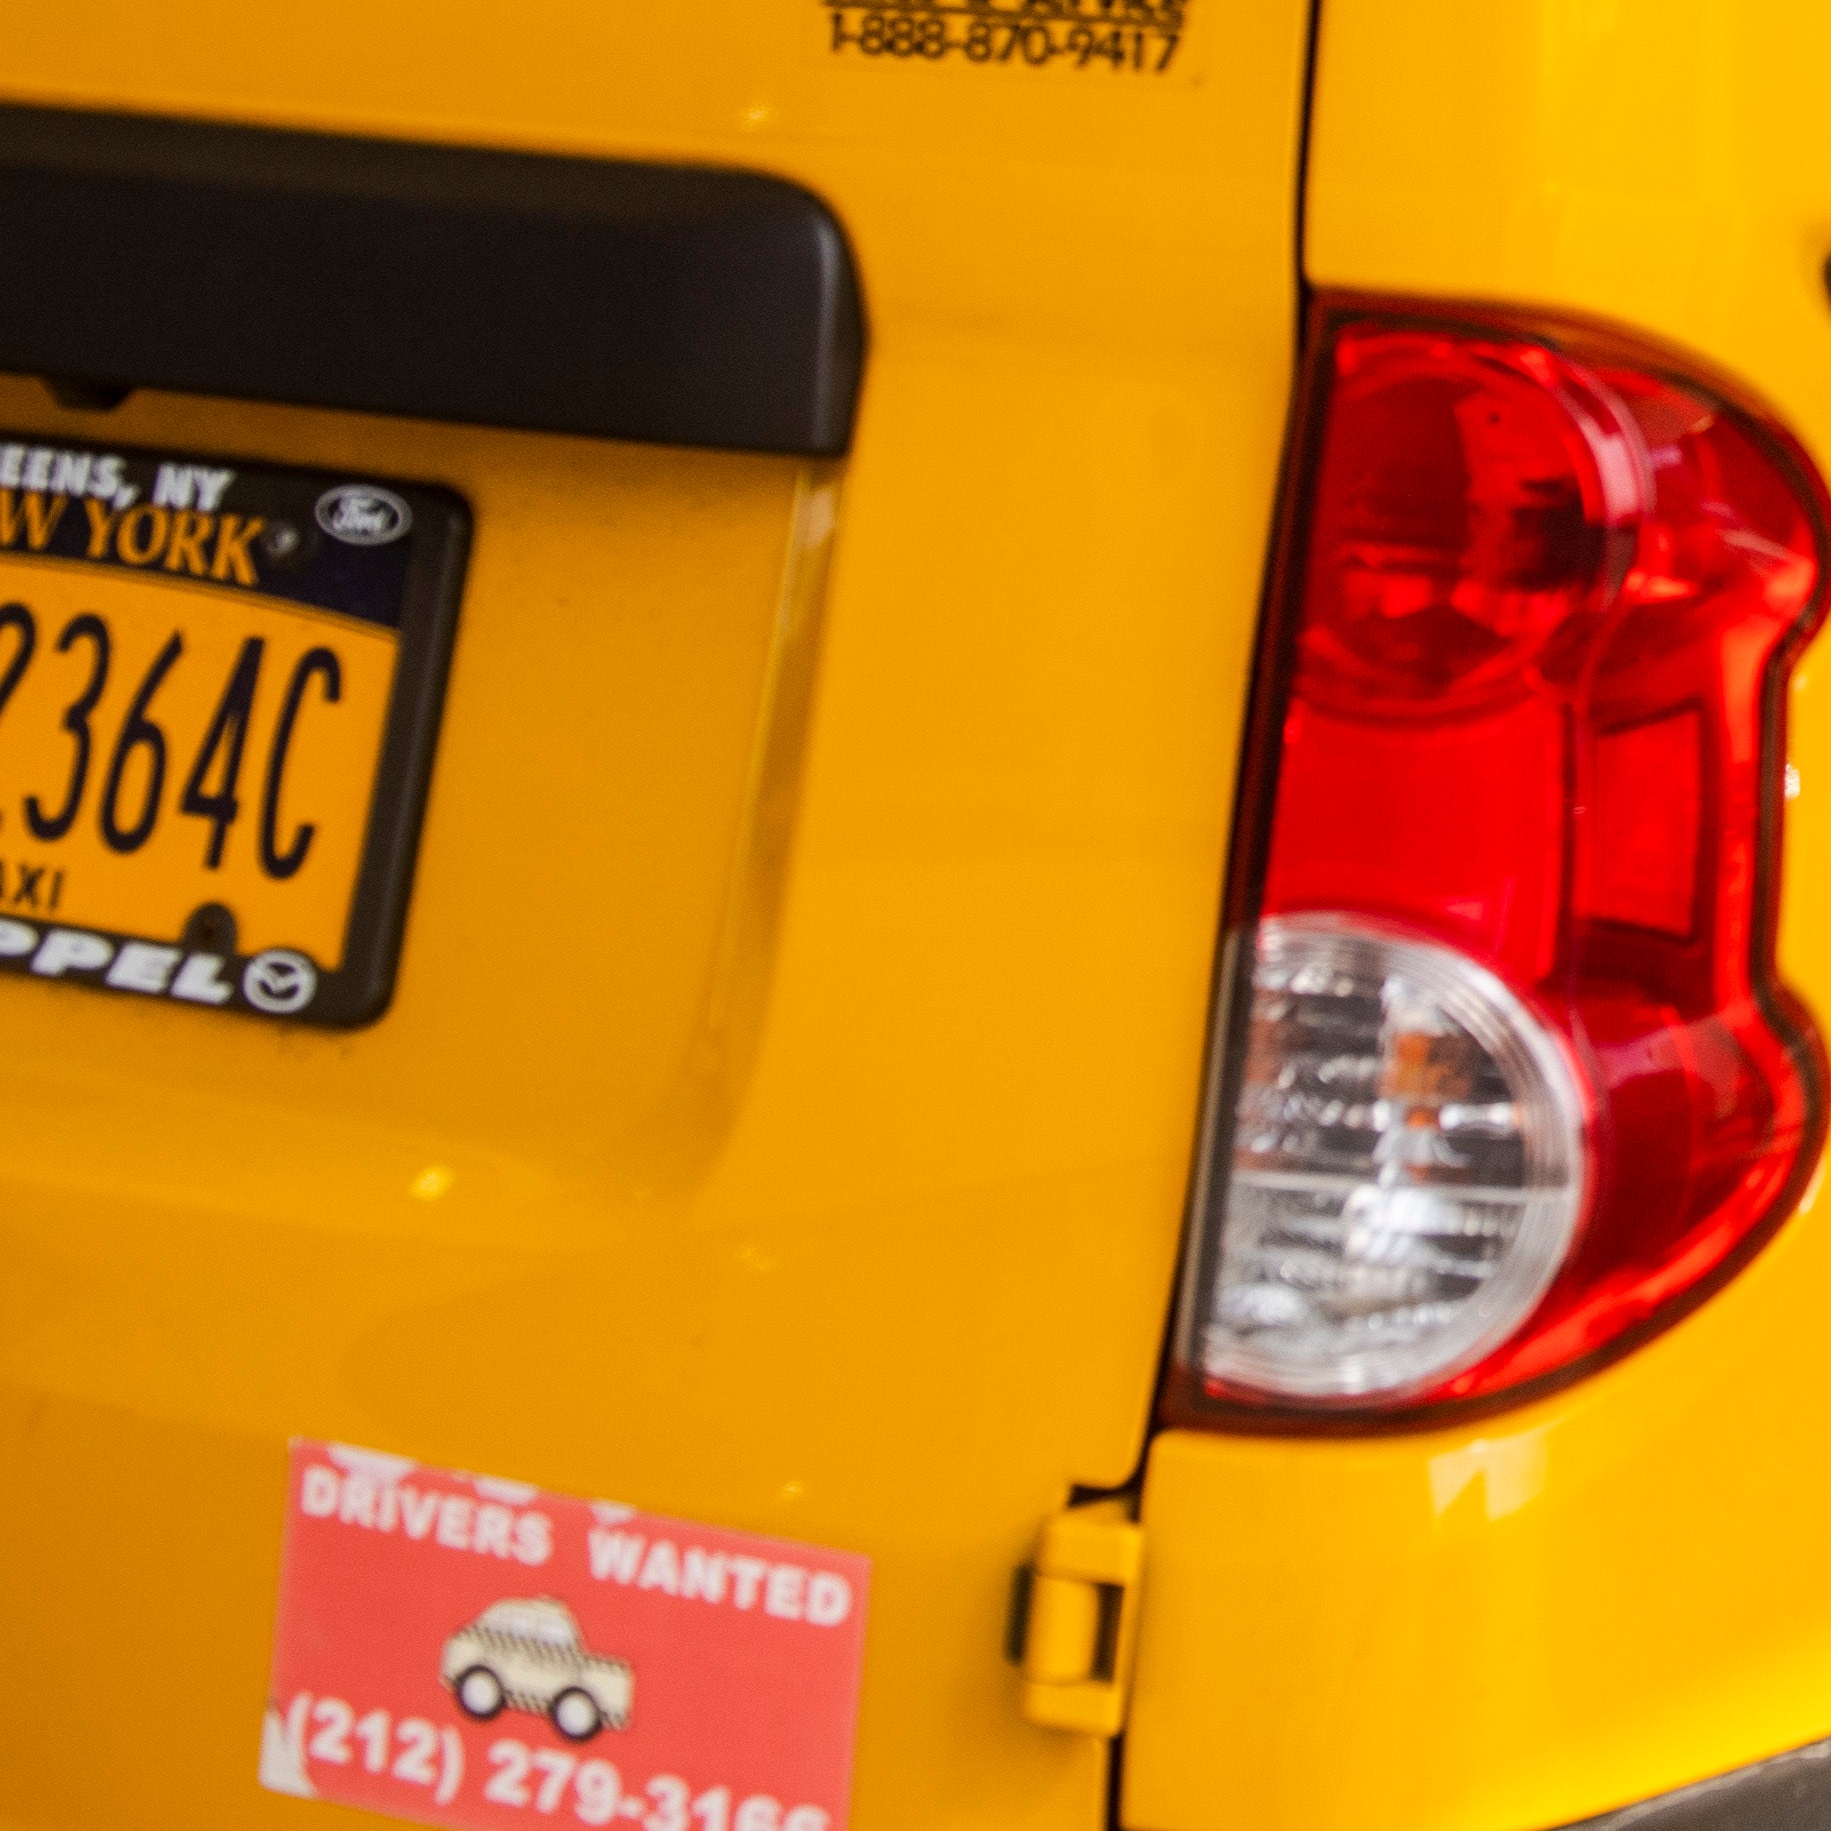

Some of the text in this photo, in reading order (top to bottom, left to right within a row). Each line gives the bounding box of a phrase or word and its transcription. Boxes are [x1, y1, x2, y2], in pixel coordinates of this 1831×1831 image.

[829, 13, 1181, 74] 1-888-870-9417
[153, 463, 236, 511] NY
[84, 494, 266, 586] YORK
[301, 1465, 852, 1627] DRIVERS WANTED
[287, 1691, 466, 1806] (212)
